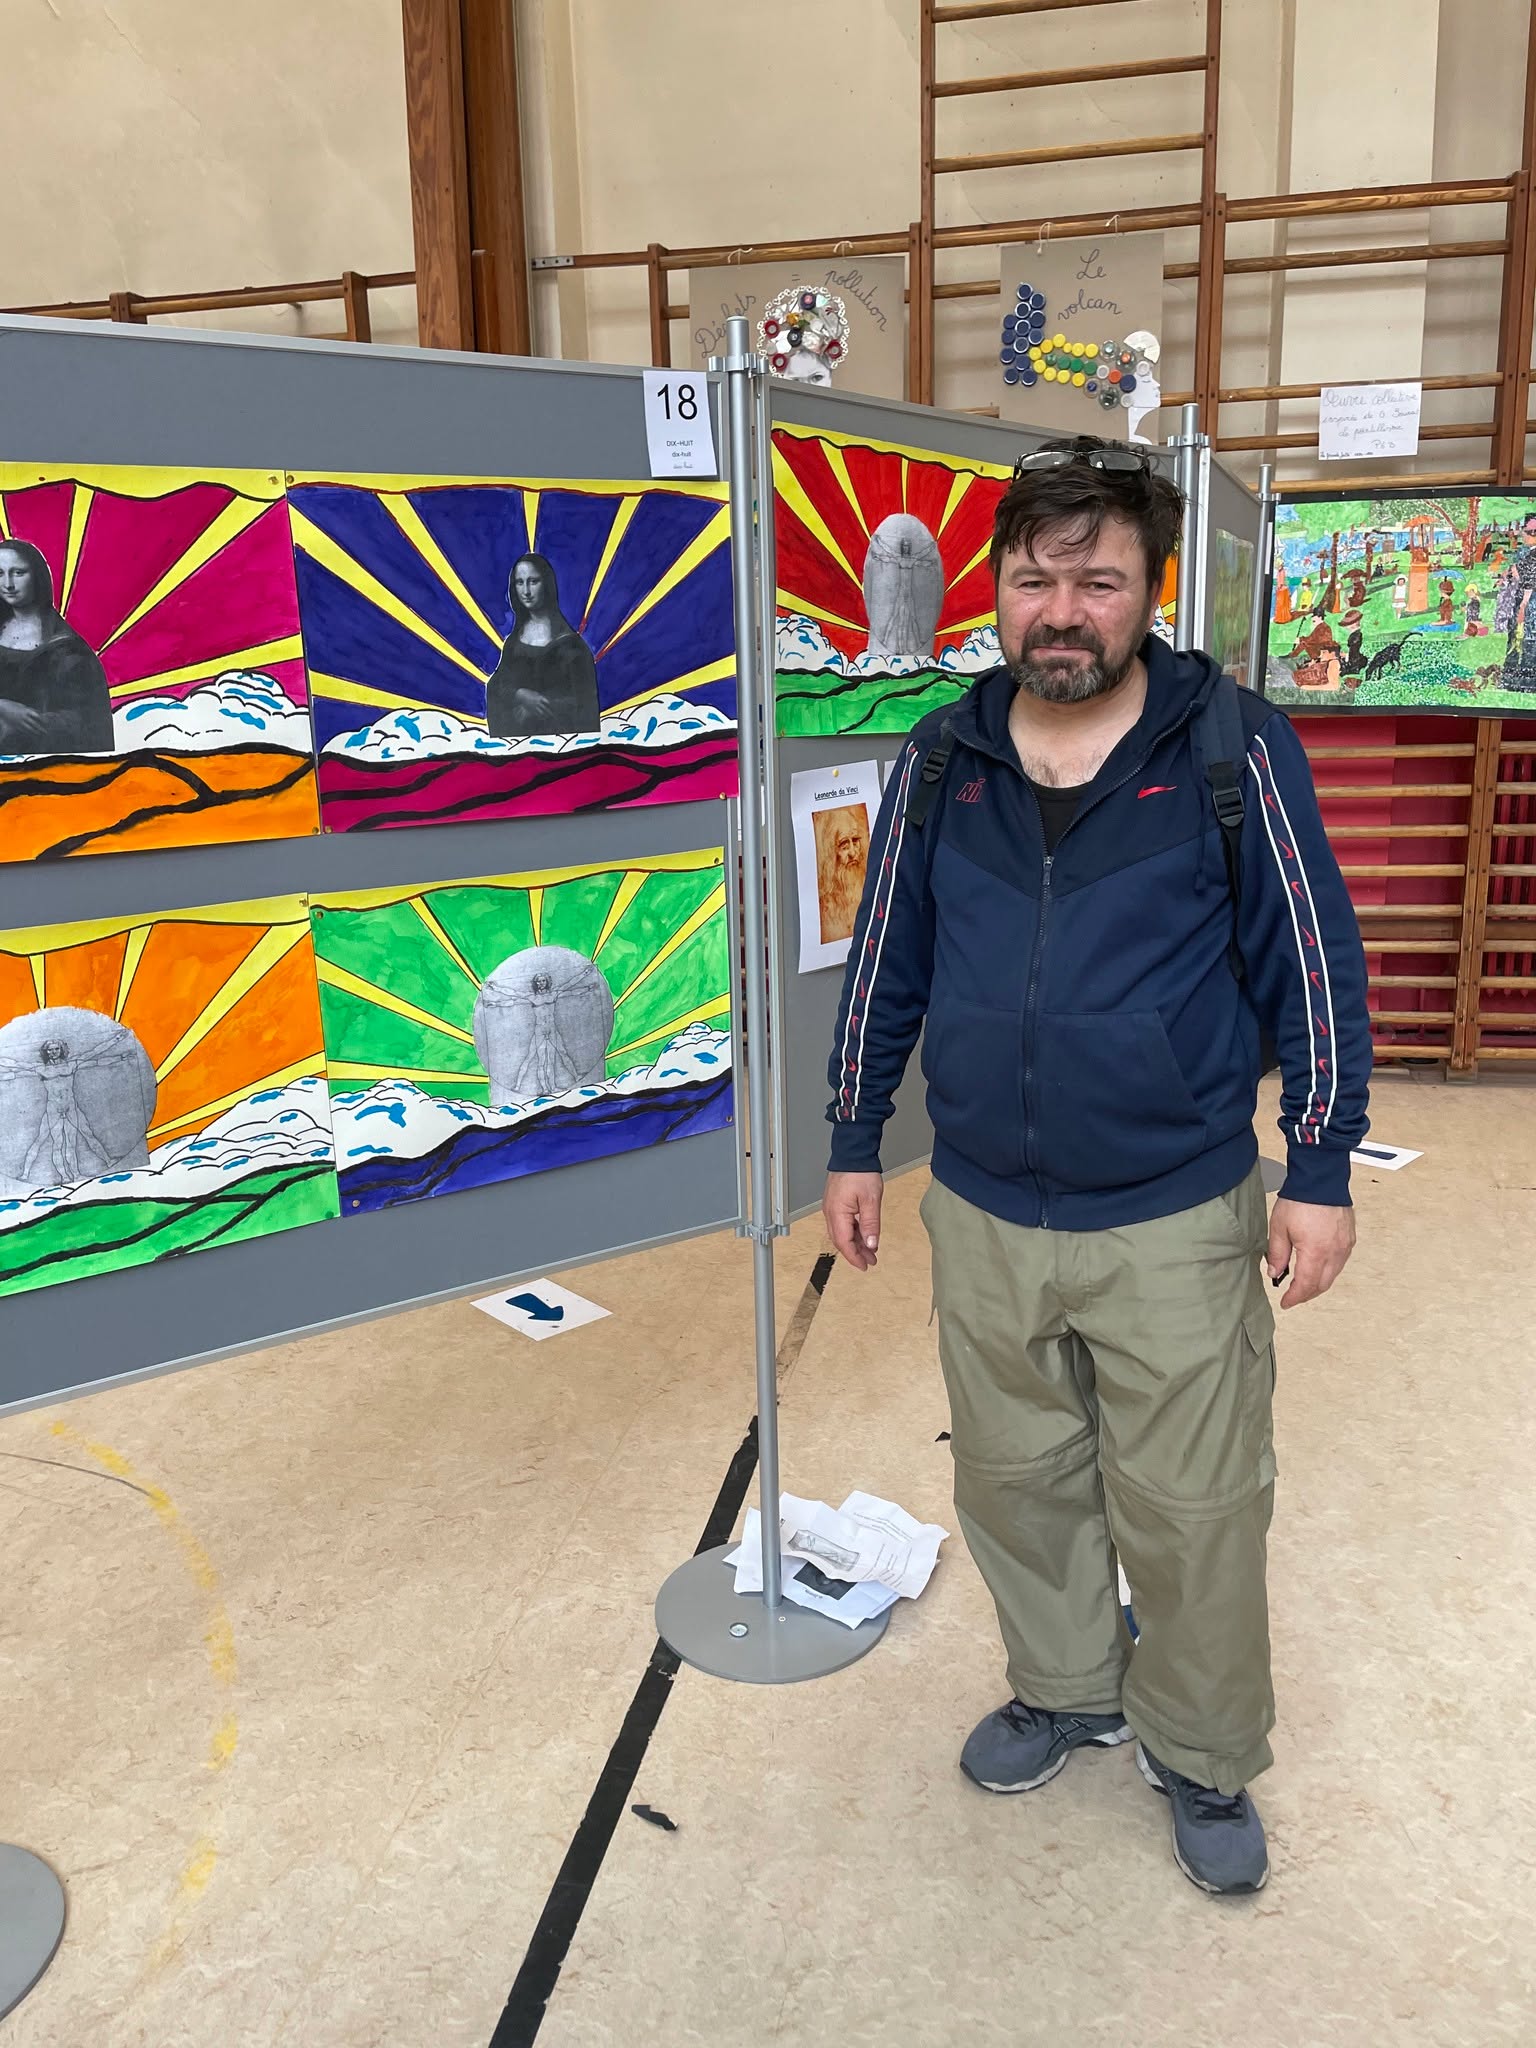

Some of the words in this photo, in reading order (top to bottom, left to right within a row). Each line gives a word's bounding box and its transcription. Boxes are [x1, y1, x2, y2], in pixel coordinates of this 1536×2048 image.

[1076, 249, 1107, 280] Le
[824, 269, 890, 332] pollution
[1057, 289, 1122, 321] volcan
[657, 383, 698, 420] 18
[814, 789, 838, 800] Leonardo
[838, 787, 846, 796] da
[846, 785, 859, 794] Vinci
